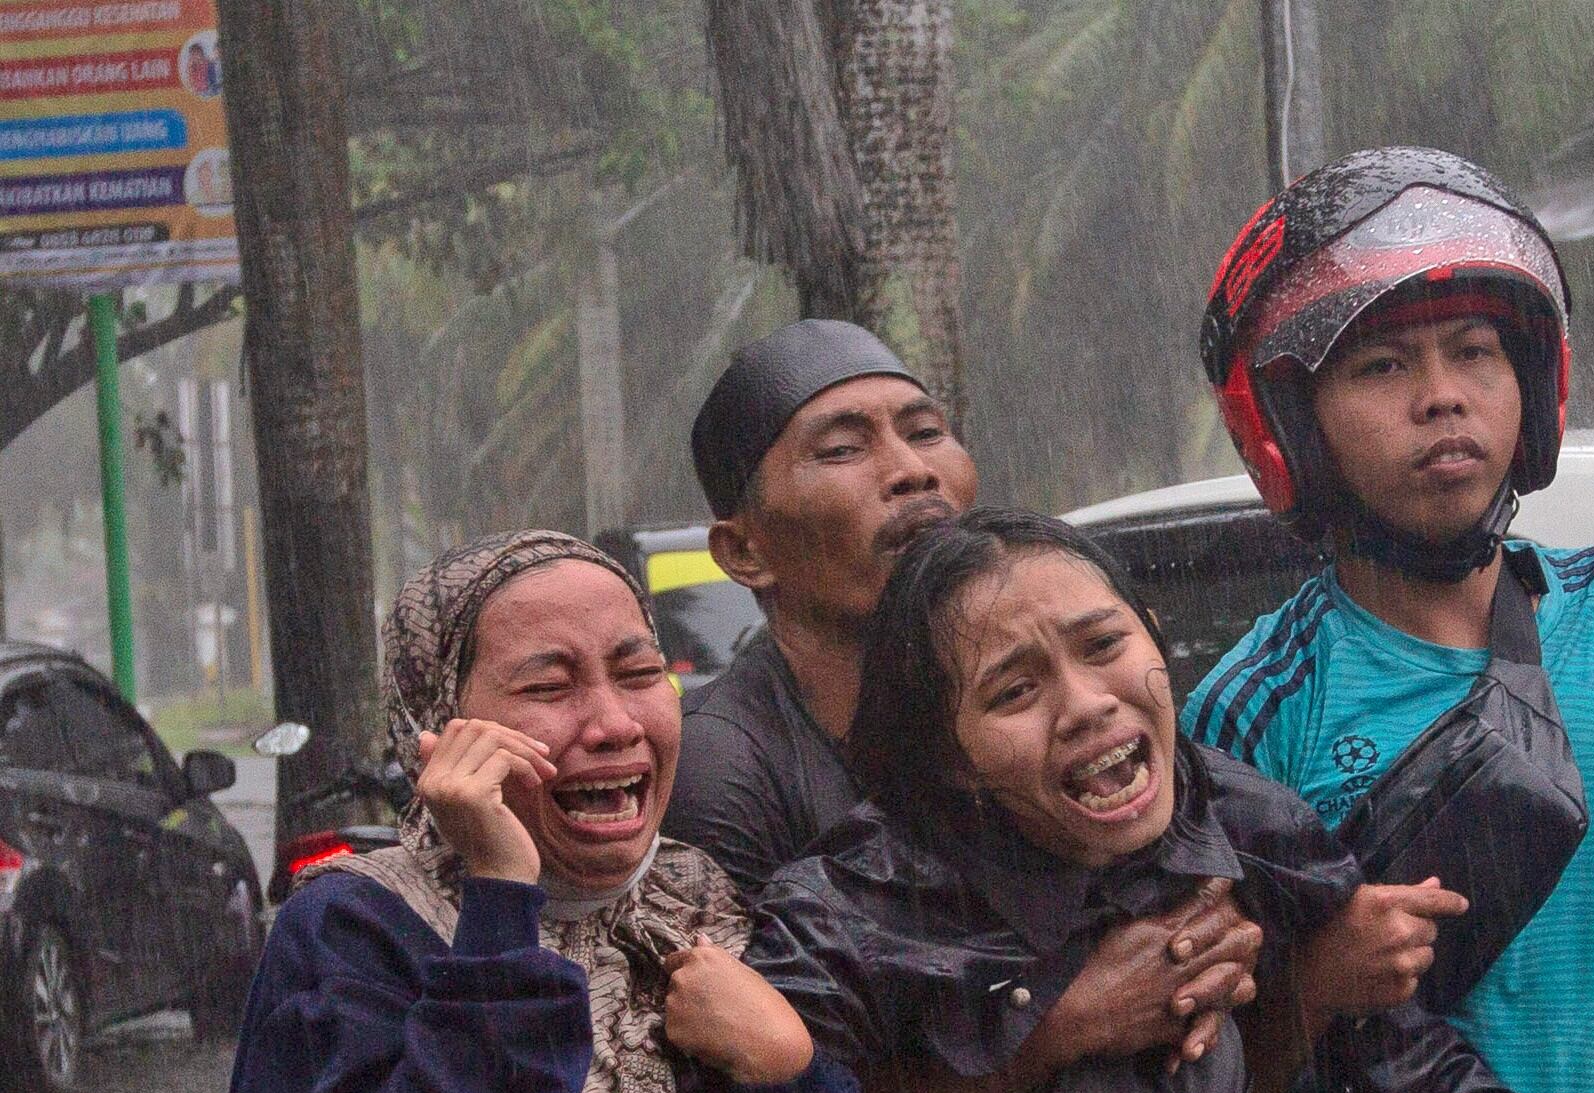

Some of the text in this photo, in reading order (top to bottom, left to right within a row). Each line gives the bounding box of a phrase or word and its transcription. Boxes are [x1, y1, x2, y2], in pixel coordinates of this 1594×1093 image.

[71, 62, 129, 84] ORANG
[130, 58, 171, 80] LAIN
[88, 176, 173, 200] KEMATIAN
